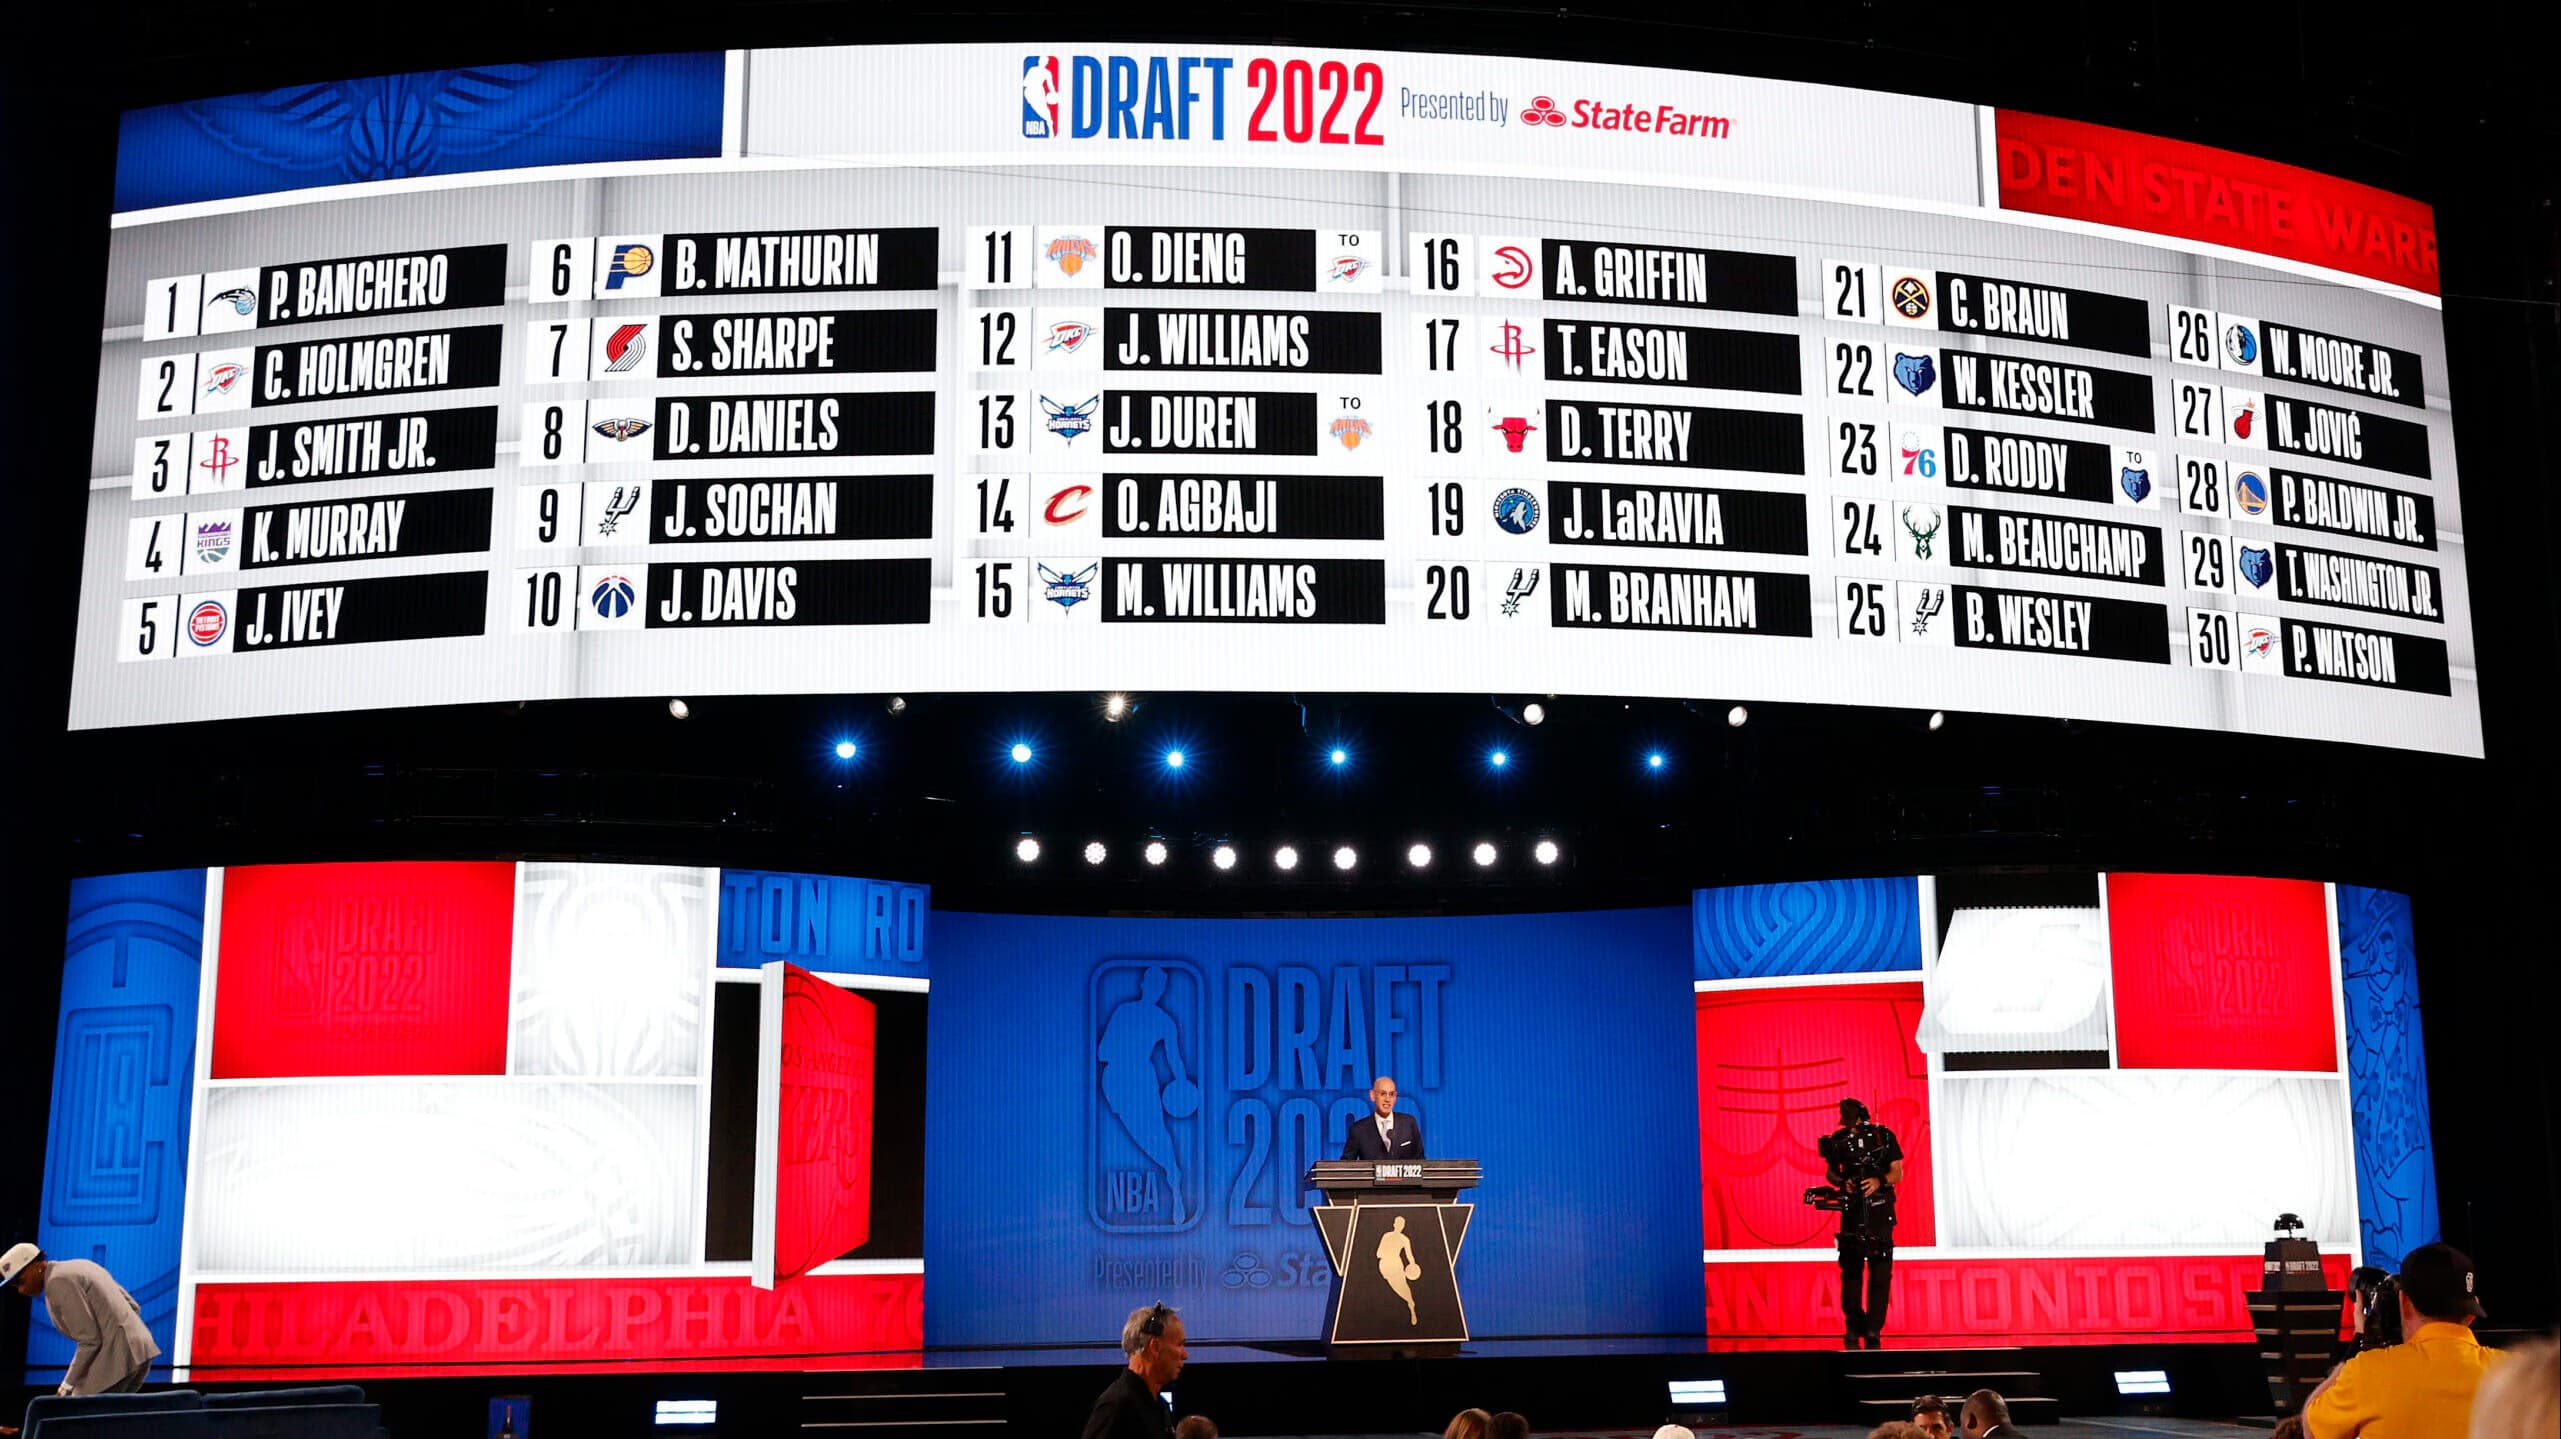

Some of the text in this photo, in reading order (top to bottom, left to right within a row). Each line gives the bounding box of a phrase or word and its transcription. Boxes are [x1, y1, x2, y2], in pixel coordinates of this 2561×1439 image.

[1071, 55, 1384, 146] DRAFT 2022
[1401, 87, 1508, 127] Presented by
[2002, 140, 2127, 206] DEN
[2143, 164, 2296, 237] STATE
[676, 234, 878, 289] B. MATHURIN
[986, 231, 1011, 283] 11
[1112, 232, 1245, 283] O. DIENG
[1338, 234, 1360, 246] TO
[1425, 239, 1458, 290] 16
[270, 255, 447, 320] P. BANCHERO
[552, 244, 571, 296] 6
[1556, 245, 1706, 302] A. GRIFFIN
[1836, 266, 1865, 317] 21
[168, 283, 177, 332] 1
[1951, 279, 2068, 339] C. BRAUN
[551, 325, 567, 377] 7
[672, 317, 834, 371] S. SHARPE
[981, 312, 1015, 365] 12
[1119, 313, 1308, 367] J. WILLIAMS
[1426, 319, 1459, 371] 17
[1558, 325, 1687, 380] T. EASON
[2178, 311, 2209, 361] 26
[2270, 328, 2399, 397] W. MOORE JR.
[158, 361, 175, 412] 2
[265, 334, 450, 400] C. HOLMGREN
[1837, 343, 1873, 396] 22
[1953, 356, 2094, 418] W. KESSLER
[669, 399, 839, 453] D. DANIELS
[979, 395, 1014, 448] 13
[1110, 396, 1256, 448] J. DUREN
[1339, 397, 1361, 409] TO
[1427, 400, 1462, 453] 18
[2183, 386, 2211, 436] 27
[259, 417, 435, 480] J. SMITH JR.
[544, 407, 562, 459] 8
[1561, 406, 1691, 461] D. TERRY
[1840, 422, 1876, 475] 23
[2276, 401, 2362, 460] N. JOVIĆ
[152, 440, 169, 492] 3
[1901, 448, 1937, 478] 76
[1952, 433, 2067, 492] D. RODDY
[2126, 451, 2142, 464] TO
[665, 482, 837, 537] J. SOCHAN
[978, 479, 1014, 532] 14
[1118, 479, 1276, 532] O. AGBAJI
[1429, 483, 1463, 536] 19
[2187, 461, 2218, 512] 28
[2282, 475, 2424, 542] P. BALDWIN JR.
[253, 500, 405, 562] K. MURRAY
[539, 489, 558, 542] 9
[1564, 488, 1724, 544] J. LaRAVIA
[1844, 502, 1881, 555] 24
[146, 521, 162, 572] 4
[1962, 512, 2146, 577] M. BEAUCHAMP
[2192, 537, 2223, 588] 29
[528, 572, 561, 627] 10
[661, 567, 796, 621] J. DAVIS
[976, 563, 1012, 617] 15
[1117, 564, 1315, 617] M. WILLIAMS
[1427, 566, 1469, 620] 20
[1566, 570, 1756, 628] M. BRANHAM
[1848, 583, 1885, 636] 25
[2286, 550, 2437, 616] T. WASHINGTON JR.
[139, 602, 157, 654] 5
[247, 587, 344, 645] J. IVEY
[1966, 592, 2091, 650] B. WESLEY
[2197, 613, 2229, 665] 30
[2292, 625, 2396, 683] P. WATSON
[725, 874, 925, 962] TON RO
[1228, 964, 1451, 1090] DRAFT
[1228, 1097, 1421, 1226] 20
[1403, 1165, 1422, 1177] 2022
[1107, 1171, 1160, 1214] NBA
[1095, 1252, 1208, 1296] Presented by
